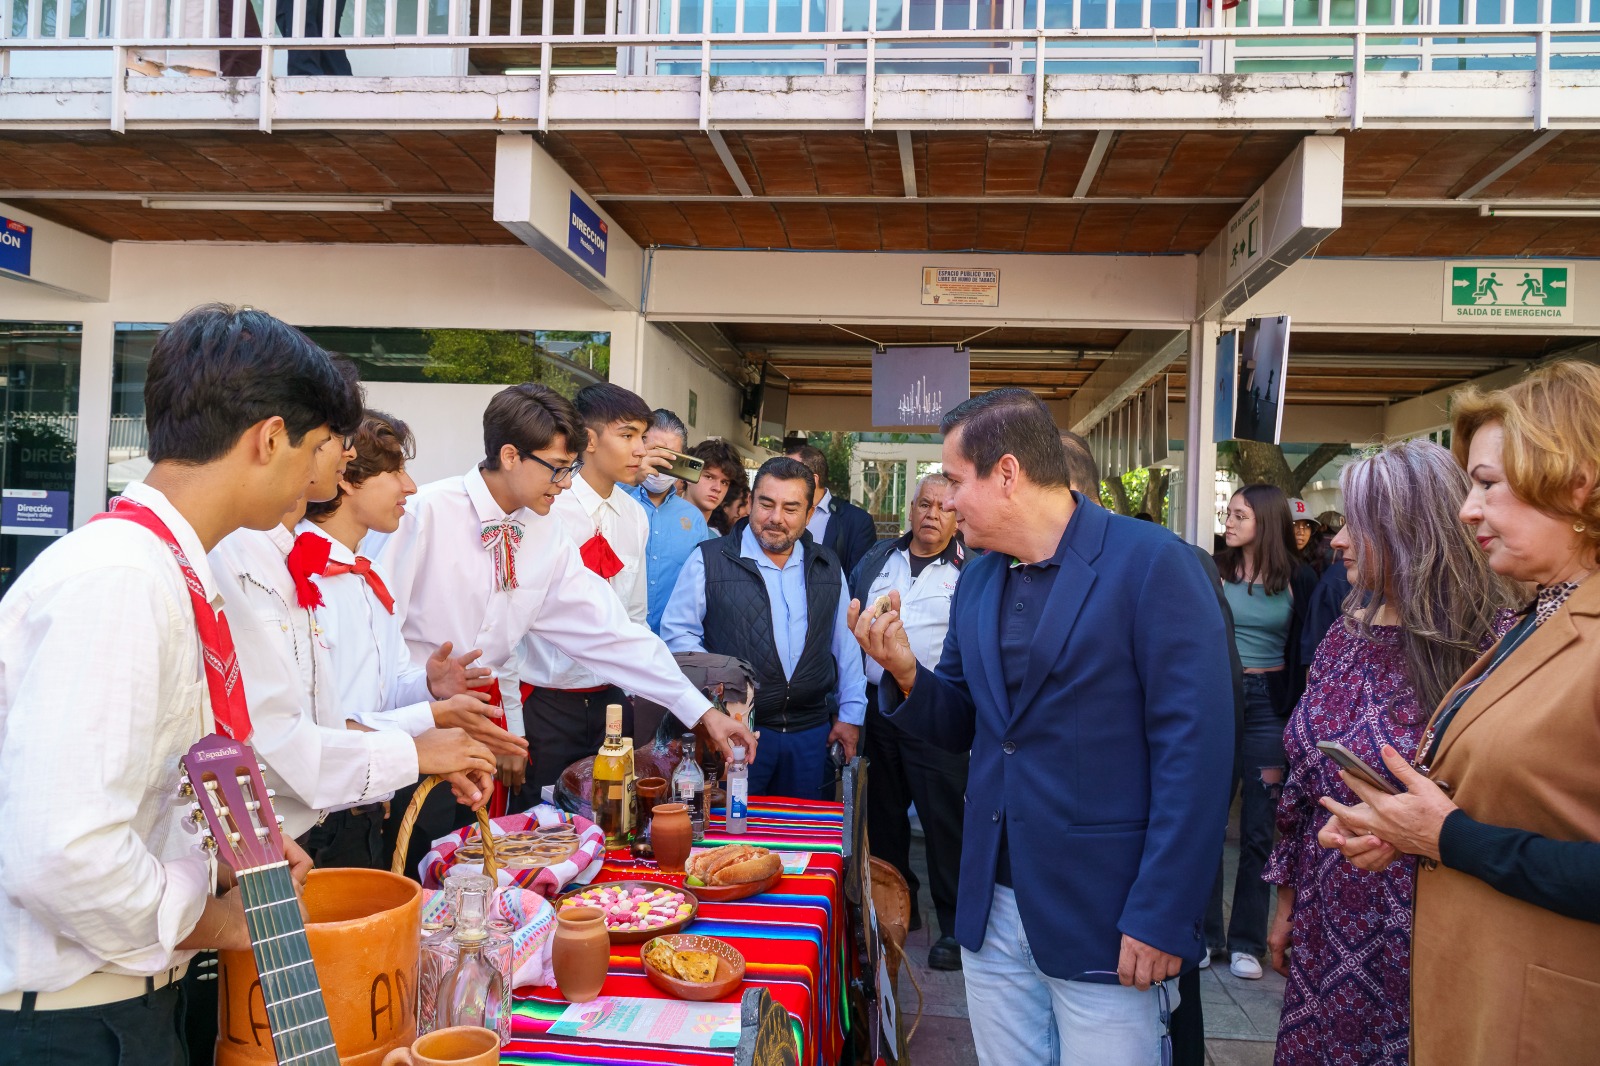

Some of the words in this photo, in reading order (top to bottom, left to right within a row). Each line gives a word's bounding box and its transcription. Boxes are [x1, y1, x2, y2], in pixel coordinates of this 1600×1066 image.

[572, 212, 605, 252] DIRECCION
[1456, 308, 1488, 316] SALIDA
[1490, 308, 1502, 317] DE
[1504, 308, 1562, 317] EMERGENCIA
[17, 504, 53, 513] Dirección
[1295, 501, 1306, 513] B
